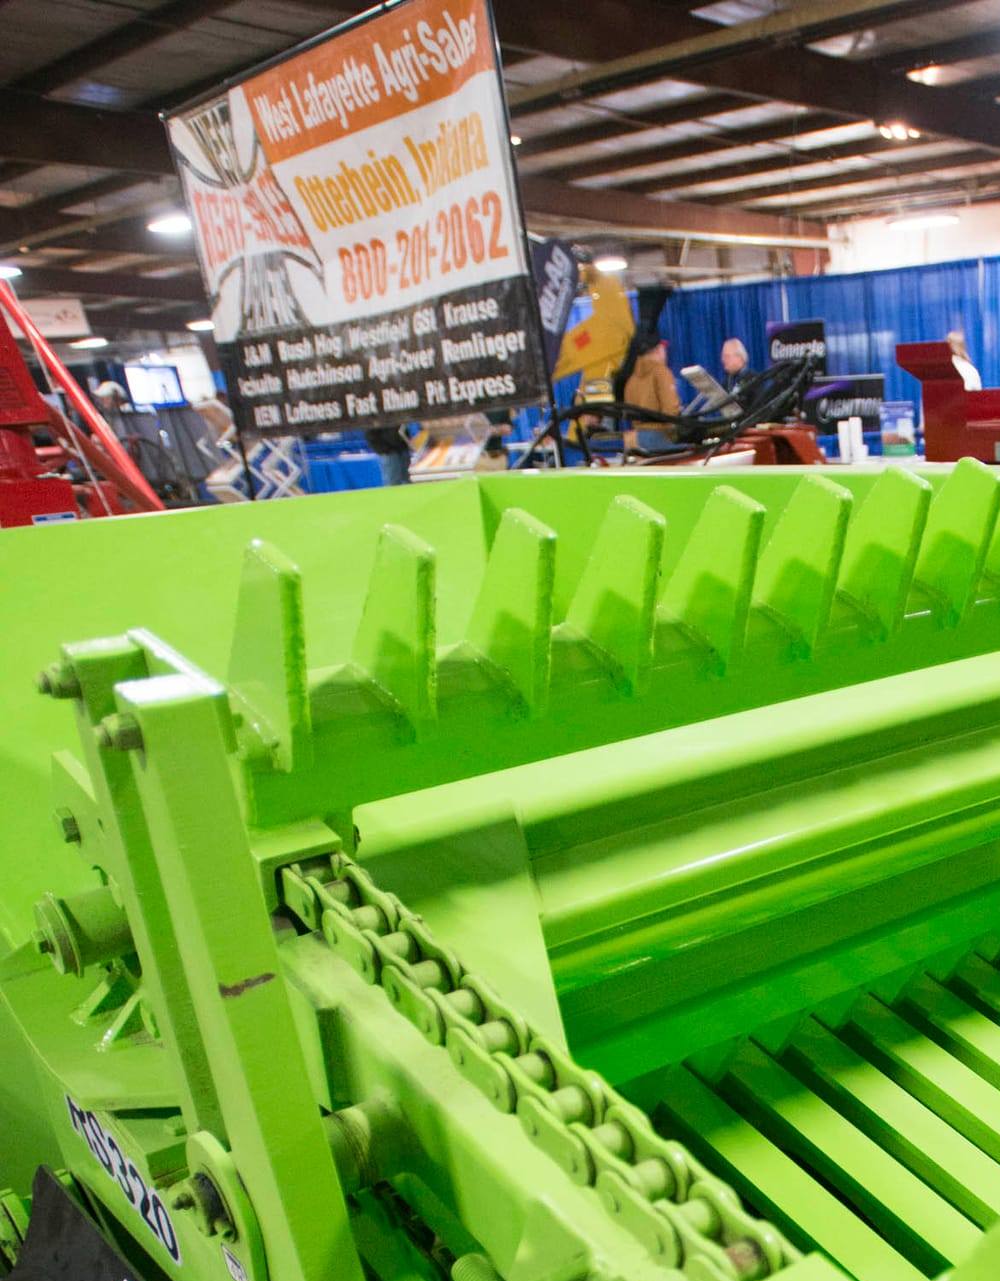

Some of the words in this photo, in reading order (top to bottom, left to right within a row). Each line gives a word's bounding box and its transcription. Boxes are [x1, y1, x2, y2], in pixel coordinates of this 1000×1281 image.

[253, 87, 302, 144] West
[290, 56, 380, 129] Lafayette
[294, 149, 422, 232] Otterbein,
[402, 111, 489, 198] Indiana
[337, 190, 509, 304] 800-201-2062
[286, 362, 364, 390] Hutchinson
[441, 330, 526, 364] Remlinger
[314, 333, 343, 359] Hog
[443, 297, 499, 328] Krause
[284, 399, 342, 424] Loftness
[345, 391, 378, 418] Fast
[381, 386, 419, 412] Rhino
[425, 378, 448, 406] Pit
[448, 373, 516, 405] Express
